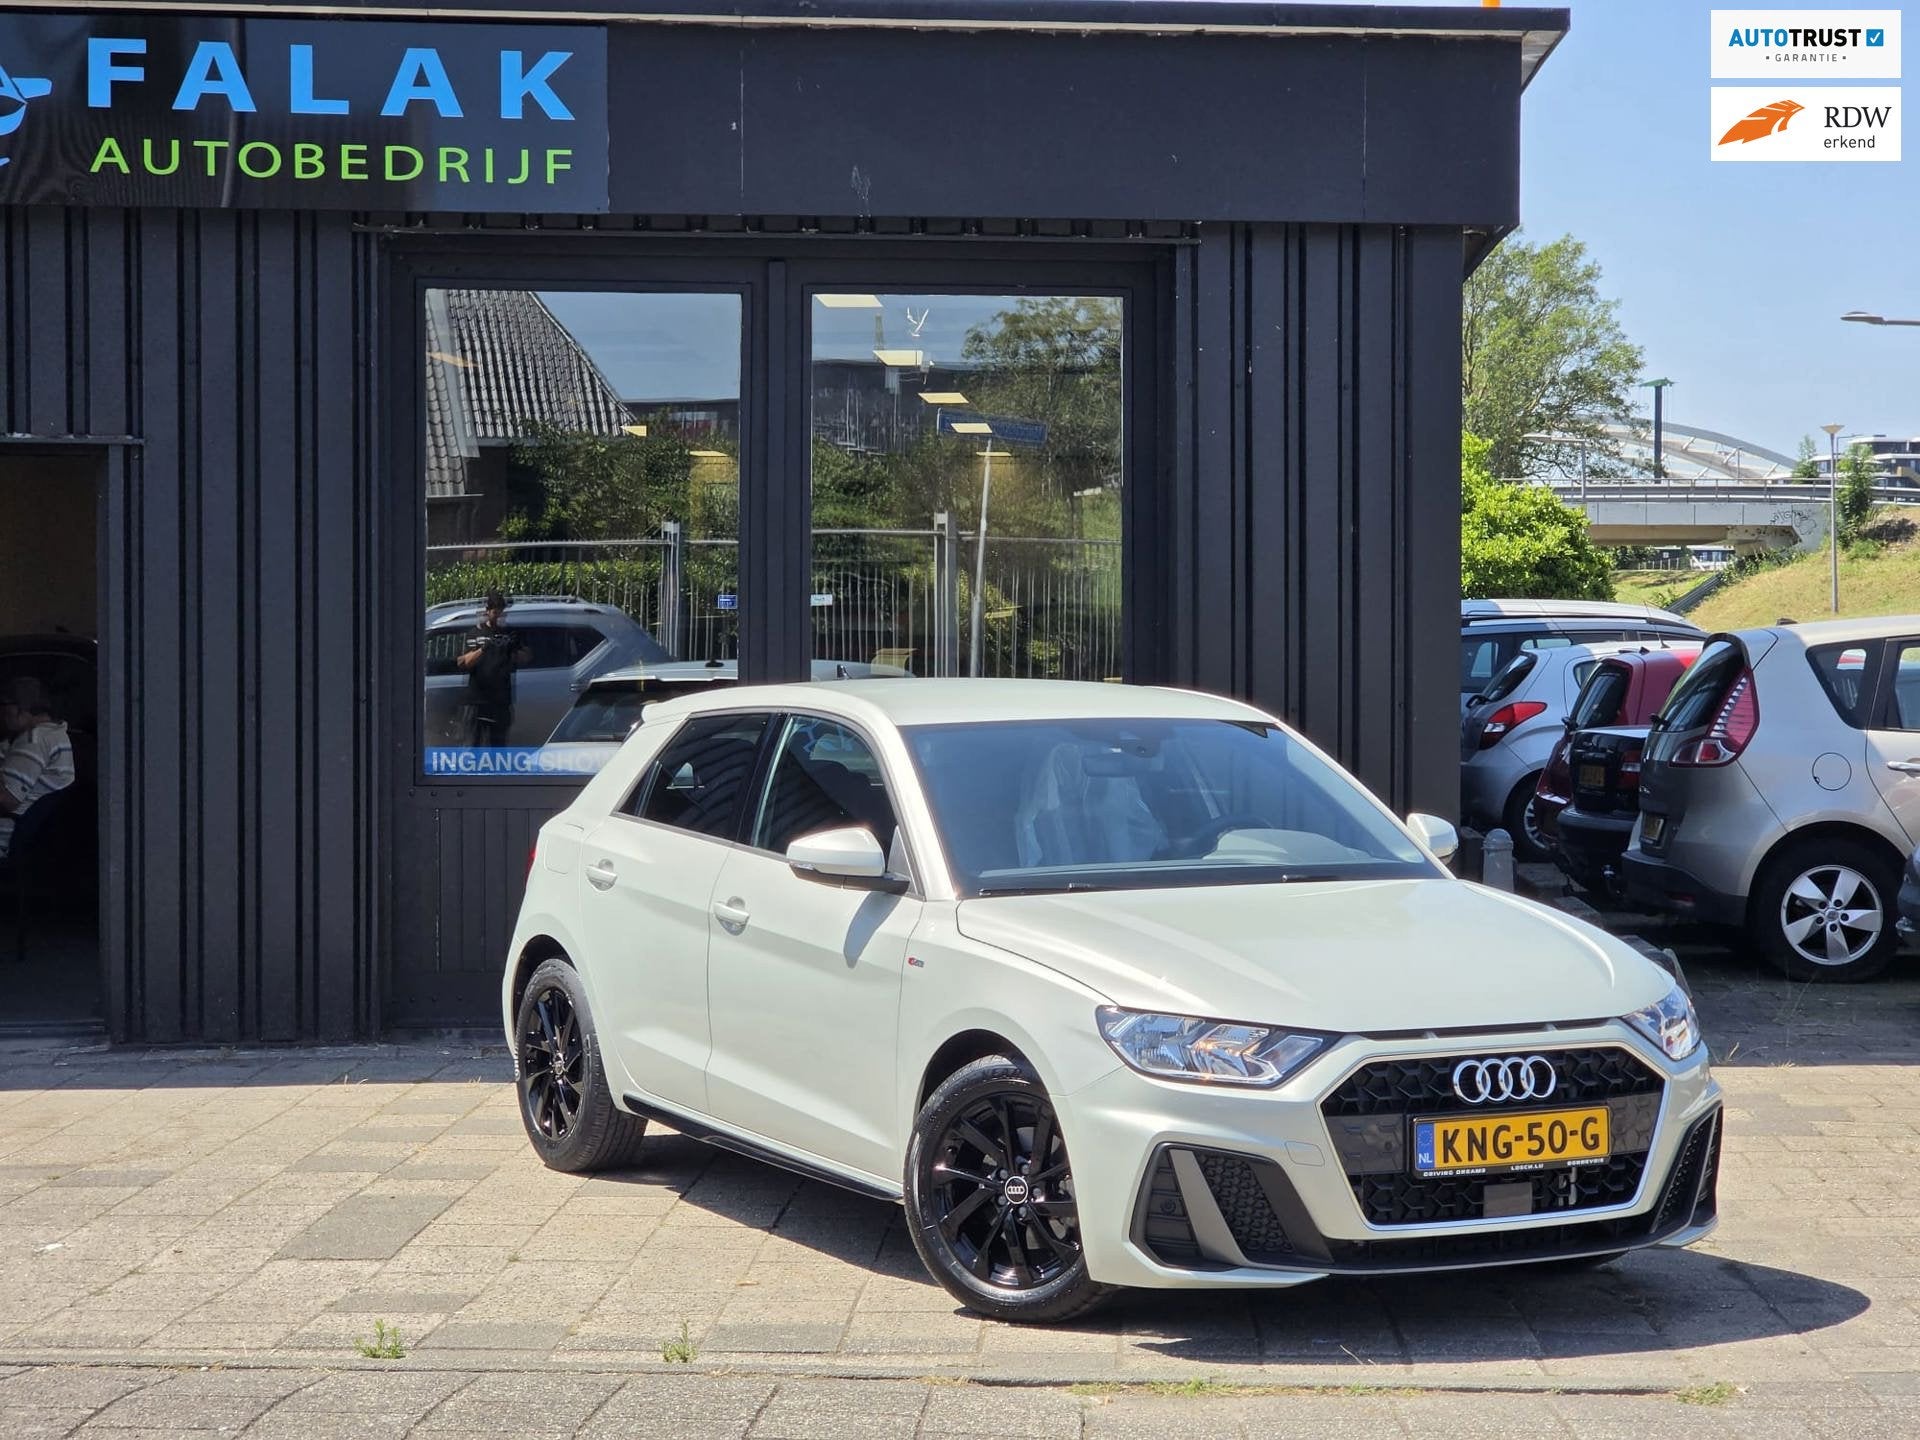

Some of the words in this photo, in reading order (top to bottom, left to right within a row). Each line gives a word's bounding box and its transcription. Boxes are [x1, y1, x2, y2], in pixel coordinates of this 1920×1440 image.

[87, 37, 576, 121] FALAK
[90, 137, 573, 185] AUTOBEDRIJF
[431, 751, 534, 772] INGANG
[1418, 1152, 1433, 1164] NL
[1442, 1116, 1600, 1164] KNG-50-G
